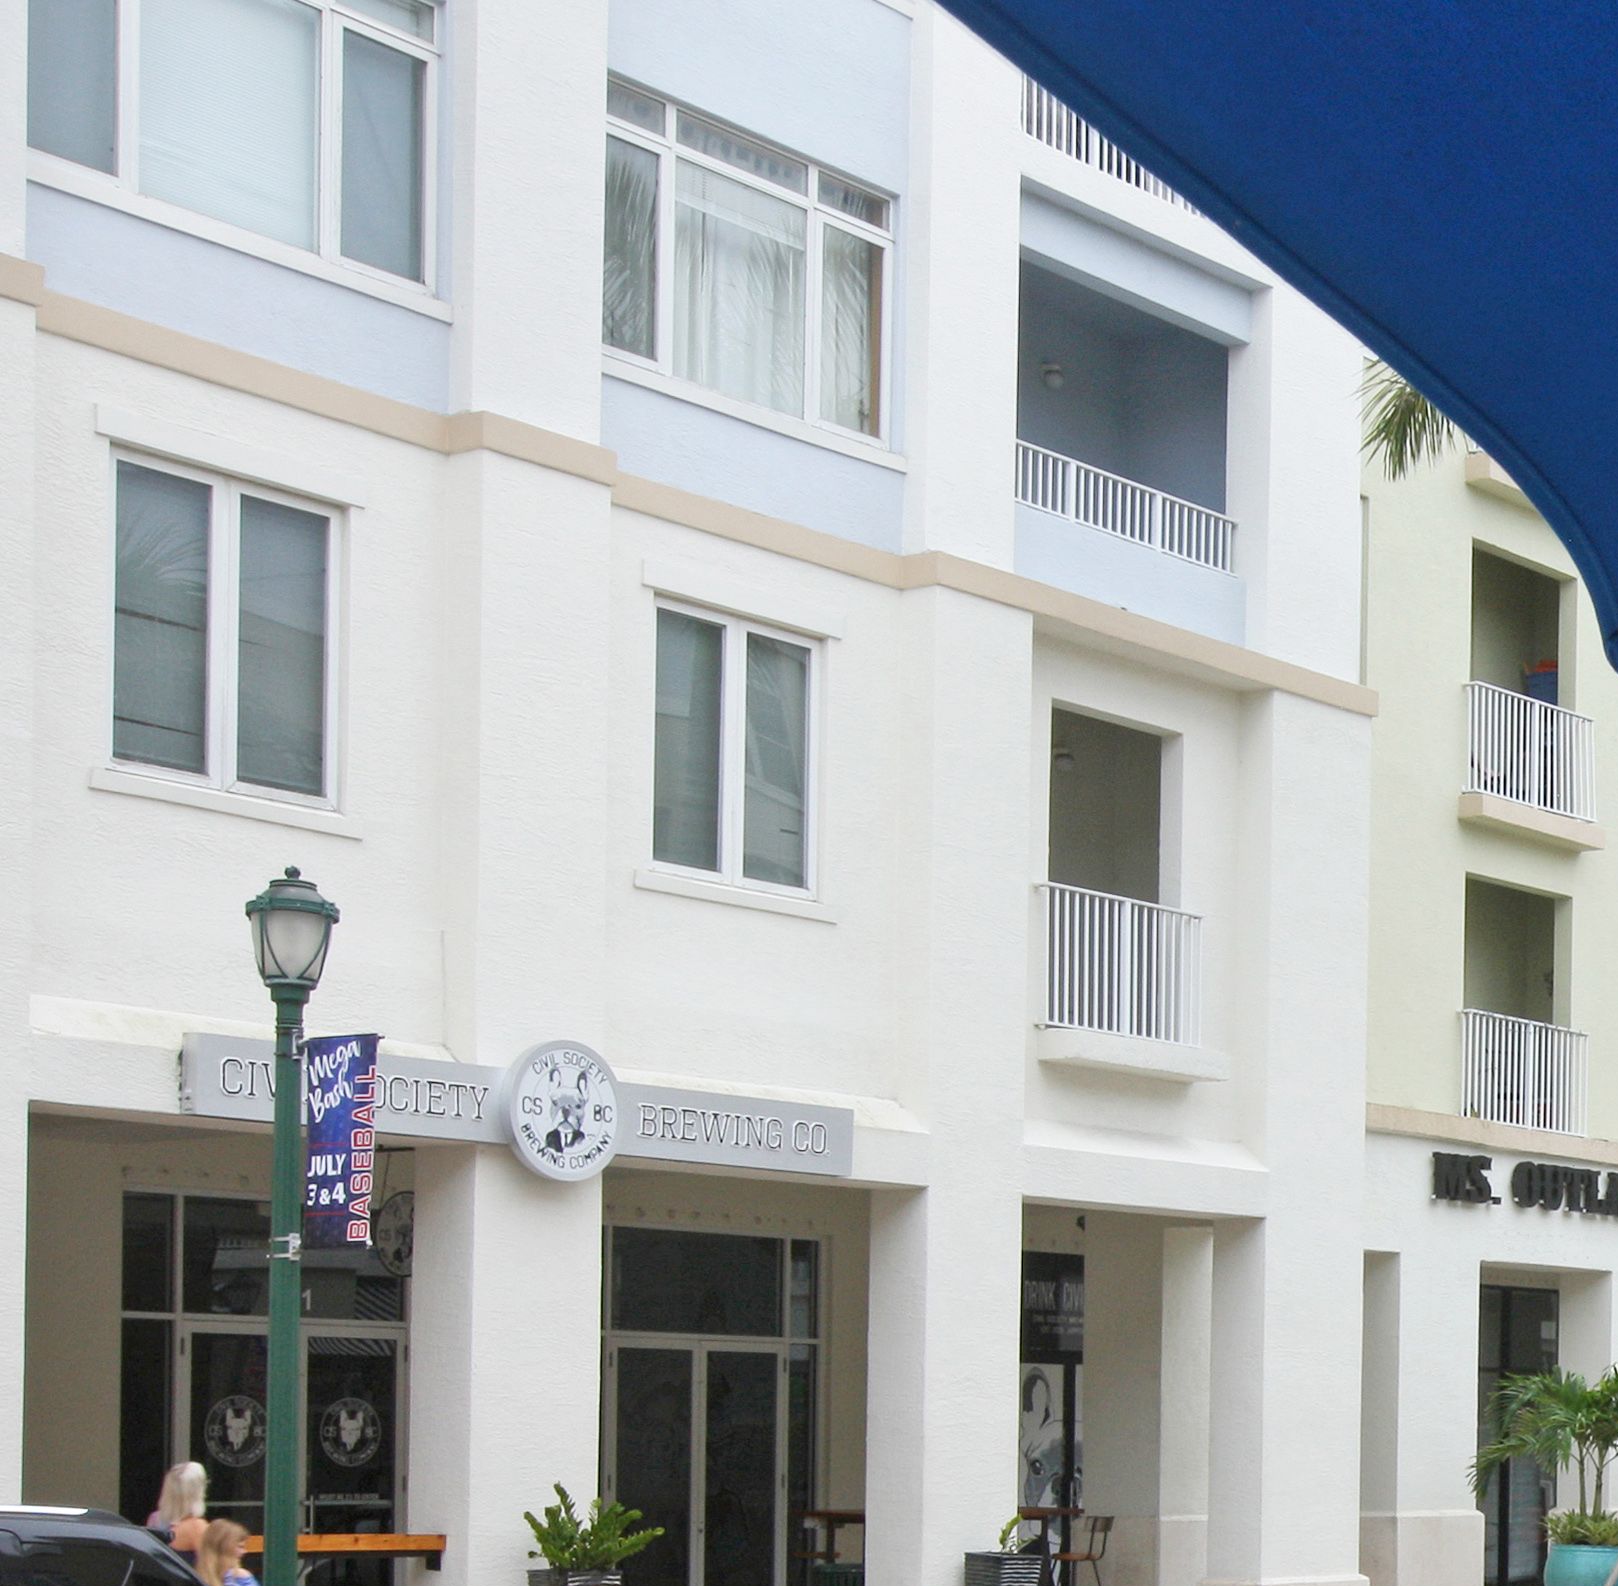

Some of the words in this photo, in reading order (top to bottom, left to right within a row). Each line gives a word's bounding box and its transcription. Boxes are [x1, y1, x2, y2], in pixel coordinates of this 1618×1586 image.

[307, 1039, 362, 1087] Mega
[532, 1053, 560, 1075] CIVIL
[563, 1051, 607, 1084] SOCIETY
[308, 1070, 354, 1124] Bash
[374, 1073, 491, 1122] OCIETY
[522, 1096, 543, 1116] CS
[593, 1104, 613, 1123] BC
[346, 1064, 378, 1242] BASEBALL
[520, 1122, 566, 1169] BREWING
[569, 1131, 613, 1169] COMPANY
[638, 1102, 784, 1151] BREWING
[791, 1120, 831, 1156] CO.
[307, 1153, 347, 1178] JULY
[1432, 1151, 1502, 1206] MS.
